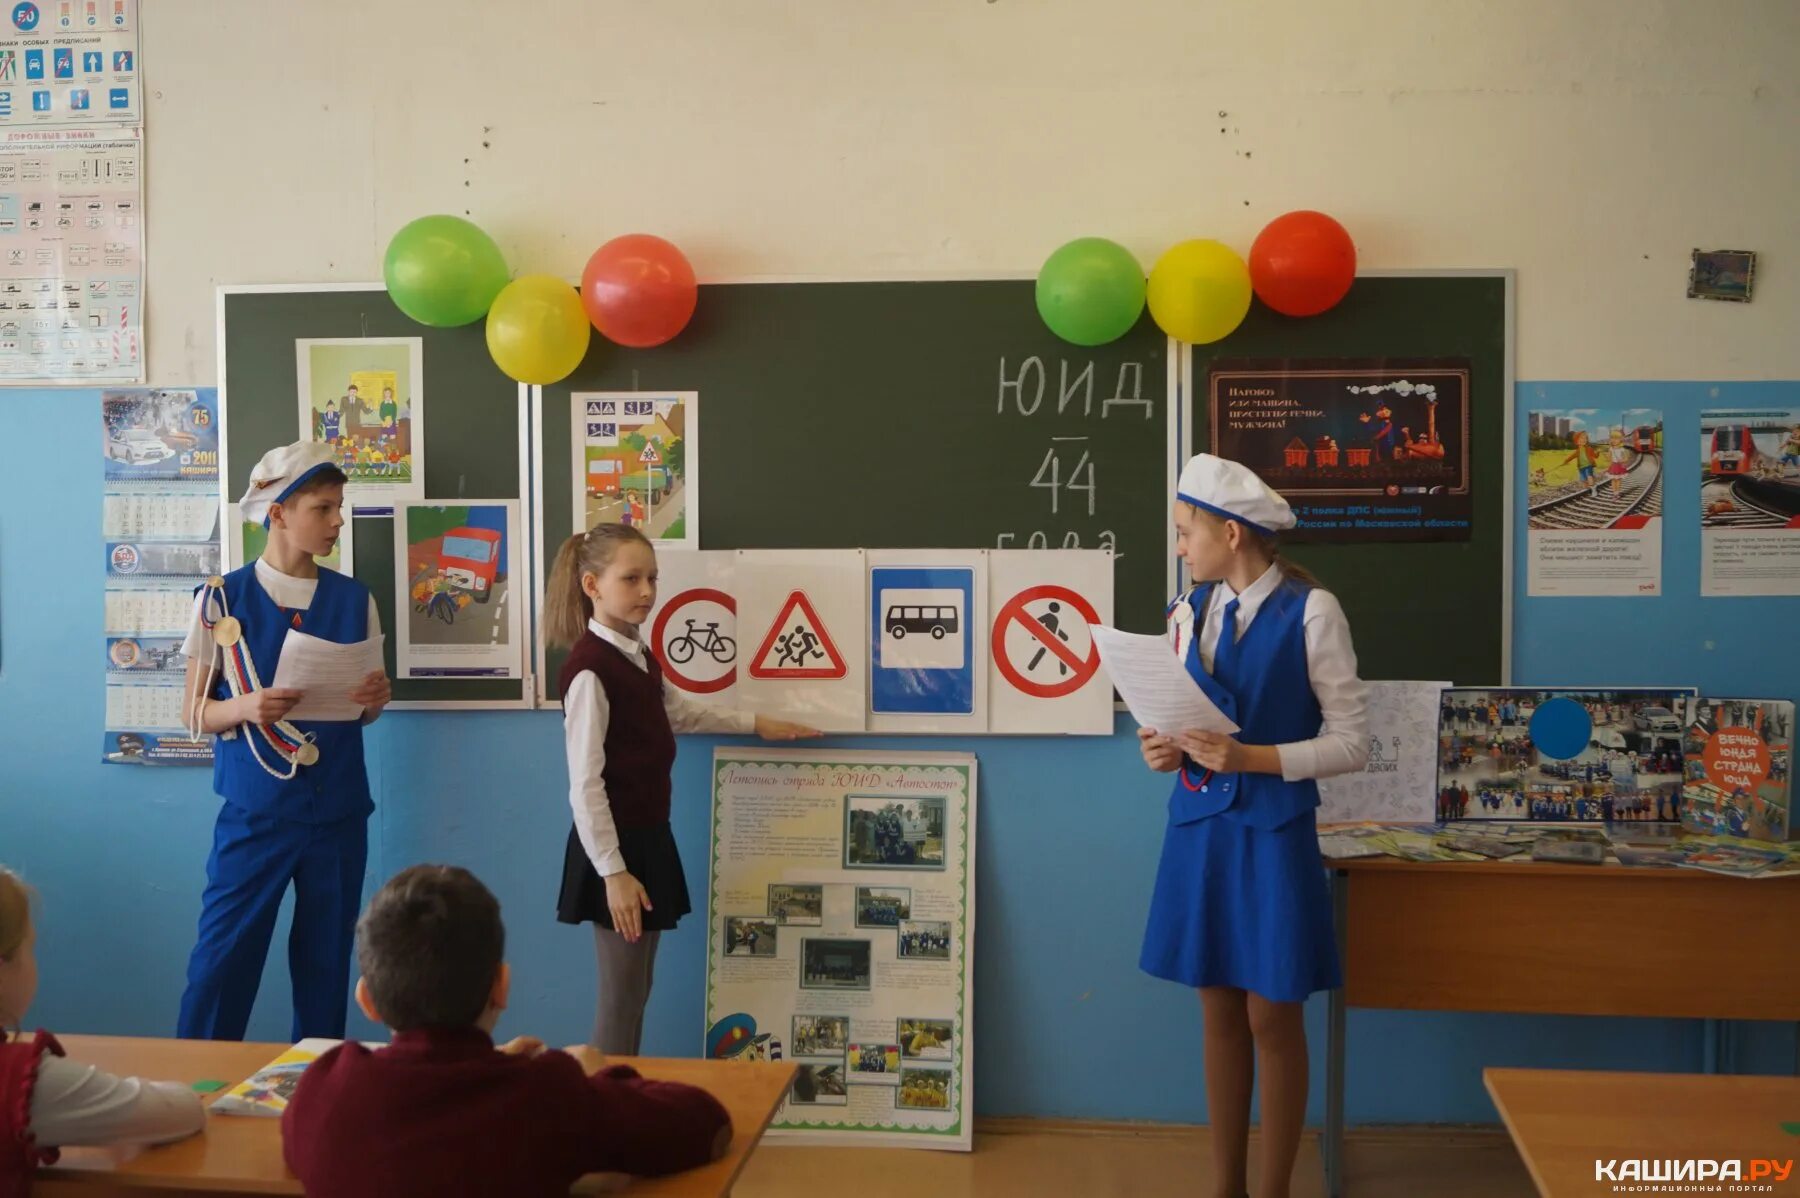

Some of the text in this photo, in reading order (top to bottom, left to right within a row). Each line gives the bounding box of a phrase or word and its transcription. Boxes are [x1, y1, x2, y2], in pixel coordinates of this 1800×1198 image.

[998, 356, 1154, 419] ЮИД
[192, 409, 208, 426] 75
[1229, 420, 1287, 429] МУЖЧИНА!
[193, 451, 217, 465] 2011
[180, 466, 217, 475] КАШИРА
[1029, 448, 1096, 515] 44
[1302, 507, 1310, 515] 2
[1347, 506, 1370, 516] ДПС
[1297, 520, 1337, 528] России
[1355, 519, 1421, 528] Московской
[1424, 519, 1469, 528] области
[1718, 734, 1760, 746] ВЕЧНО
[1719, 747, 1757, 760] ЮНАЯ
[1713, 760, 1762, 775] СТРАНА
[722, 770, 778, 786] Летопись
[783, 774, 825, 791] отряда
[831, 773, 881, 787] ЮИД
